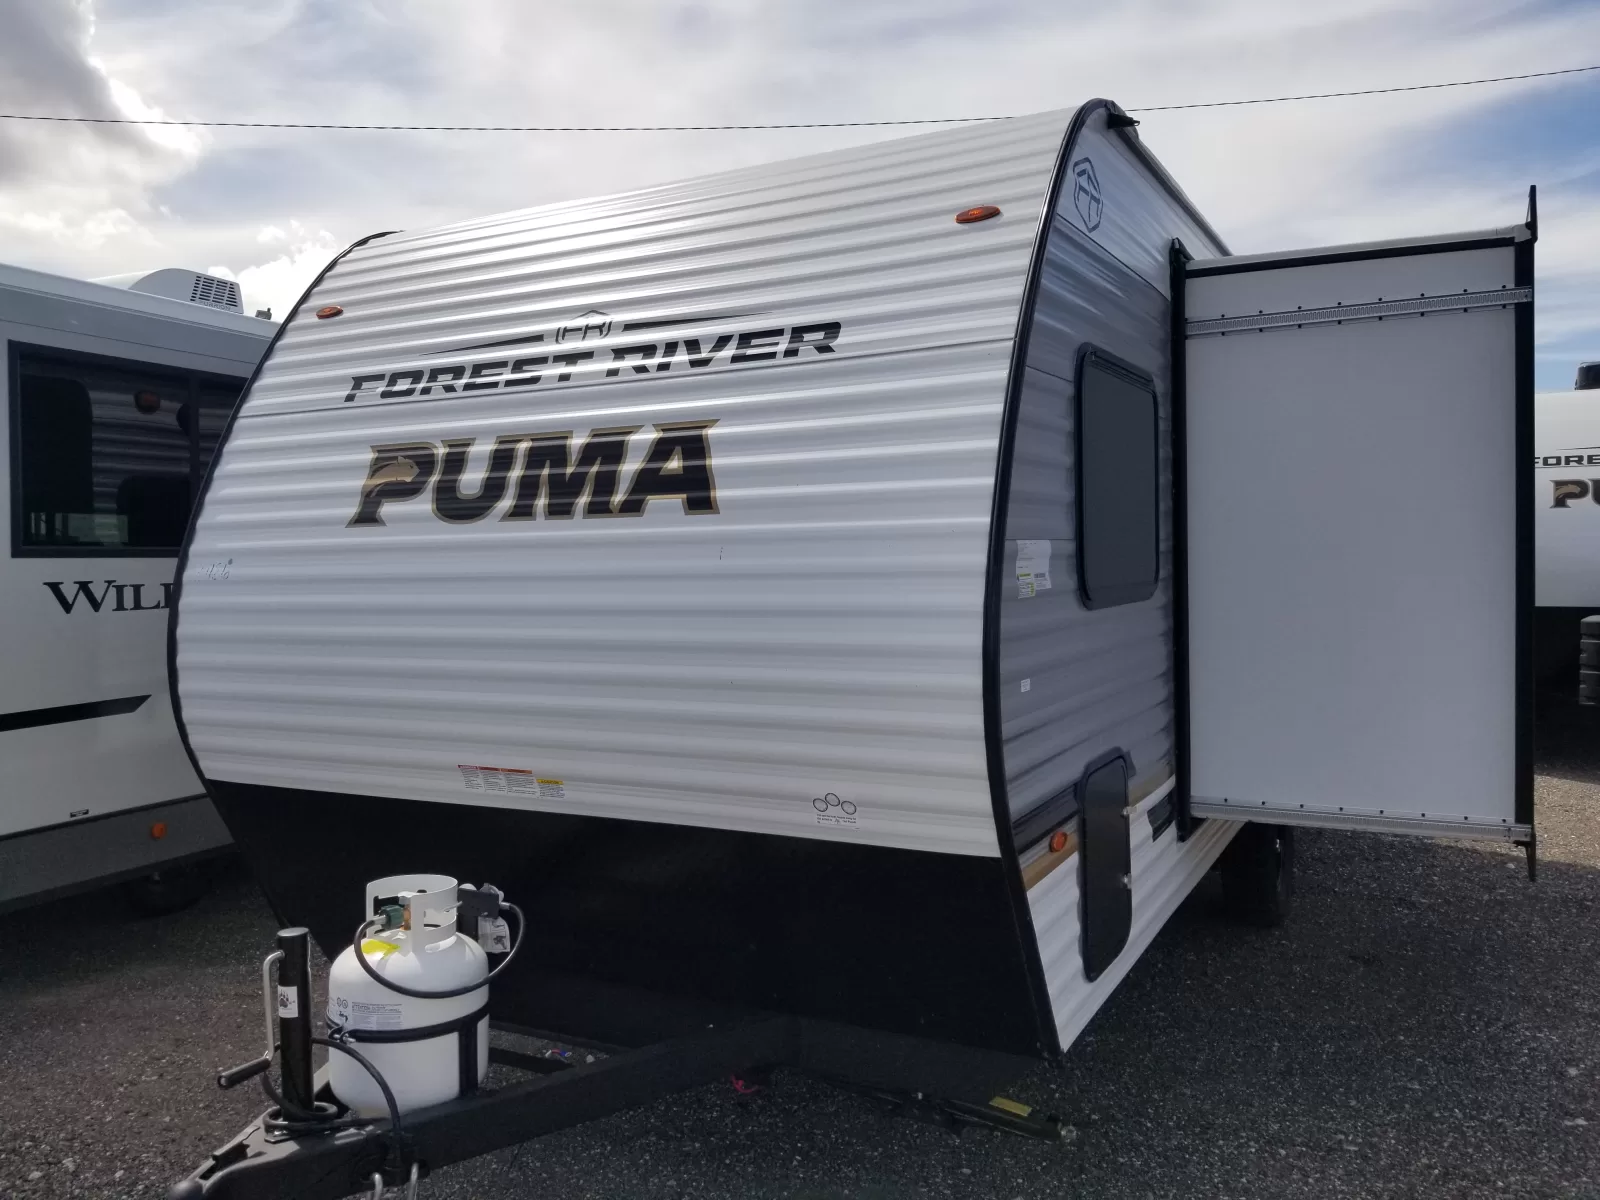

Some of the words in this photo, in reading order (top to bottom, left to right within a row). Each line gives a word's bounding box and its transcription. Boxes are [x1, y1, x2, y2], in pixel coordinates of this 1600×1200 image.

[344, 351, 595, 403] FOREST
[605, 321, 842, 378] RIVER
[345, 418, 721, 528] PUMA
